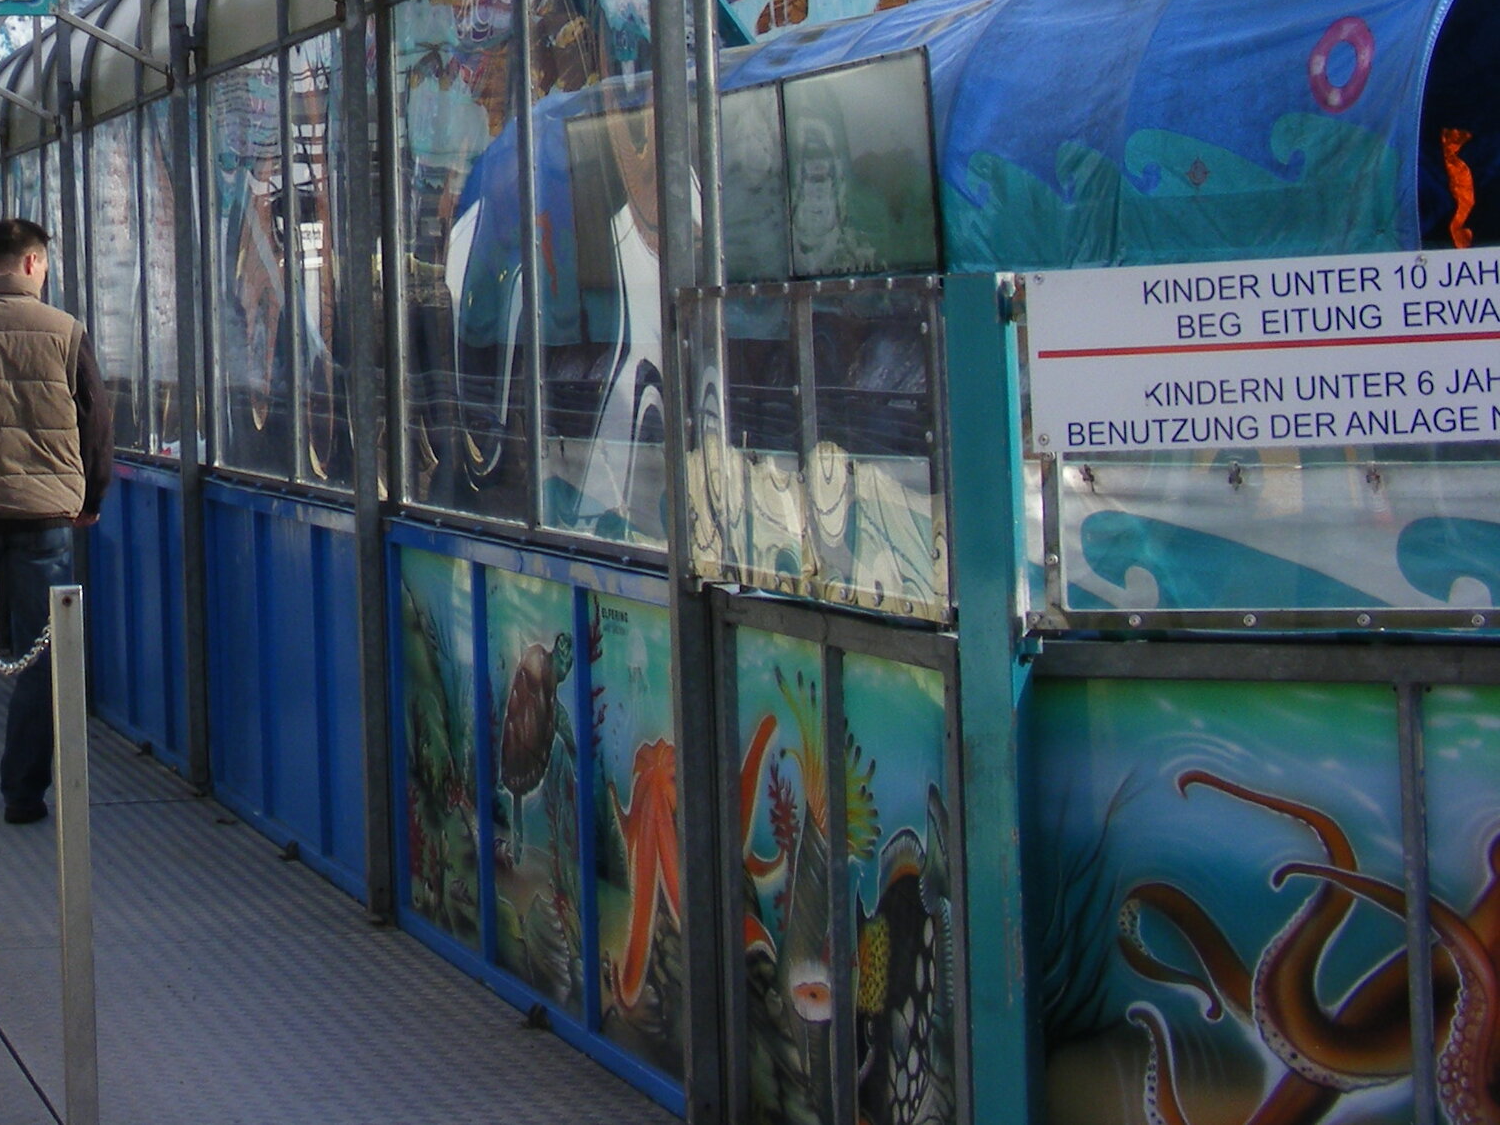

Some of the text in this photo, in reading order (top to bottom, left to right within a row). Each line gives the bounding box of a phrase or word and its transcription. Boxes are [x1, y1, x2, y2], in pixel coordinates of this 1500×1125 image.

[1143, 259, 1499, 305] KINDER UNTER 10 JAH
[1403, 297, 1500, 327] ERWA
[1144, 377, 1284, 407] KINDERN
[1296, 370, 1407, 402] UNTER
[1417, 370, 1434, 396] 6
[1067, 415, 1259, 447] BENUTZUNG
[1270, 410, 1336, 440] DER
[1344, 406, 1480, 438] ANLAGE
